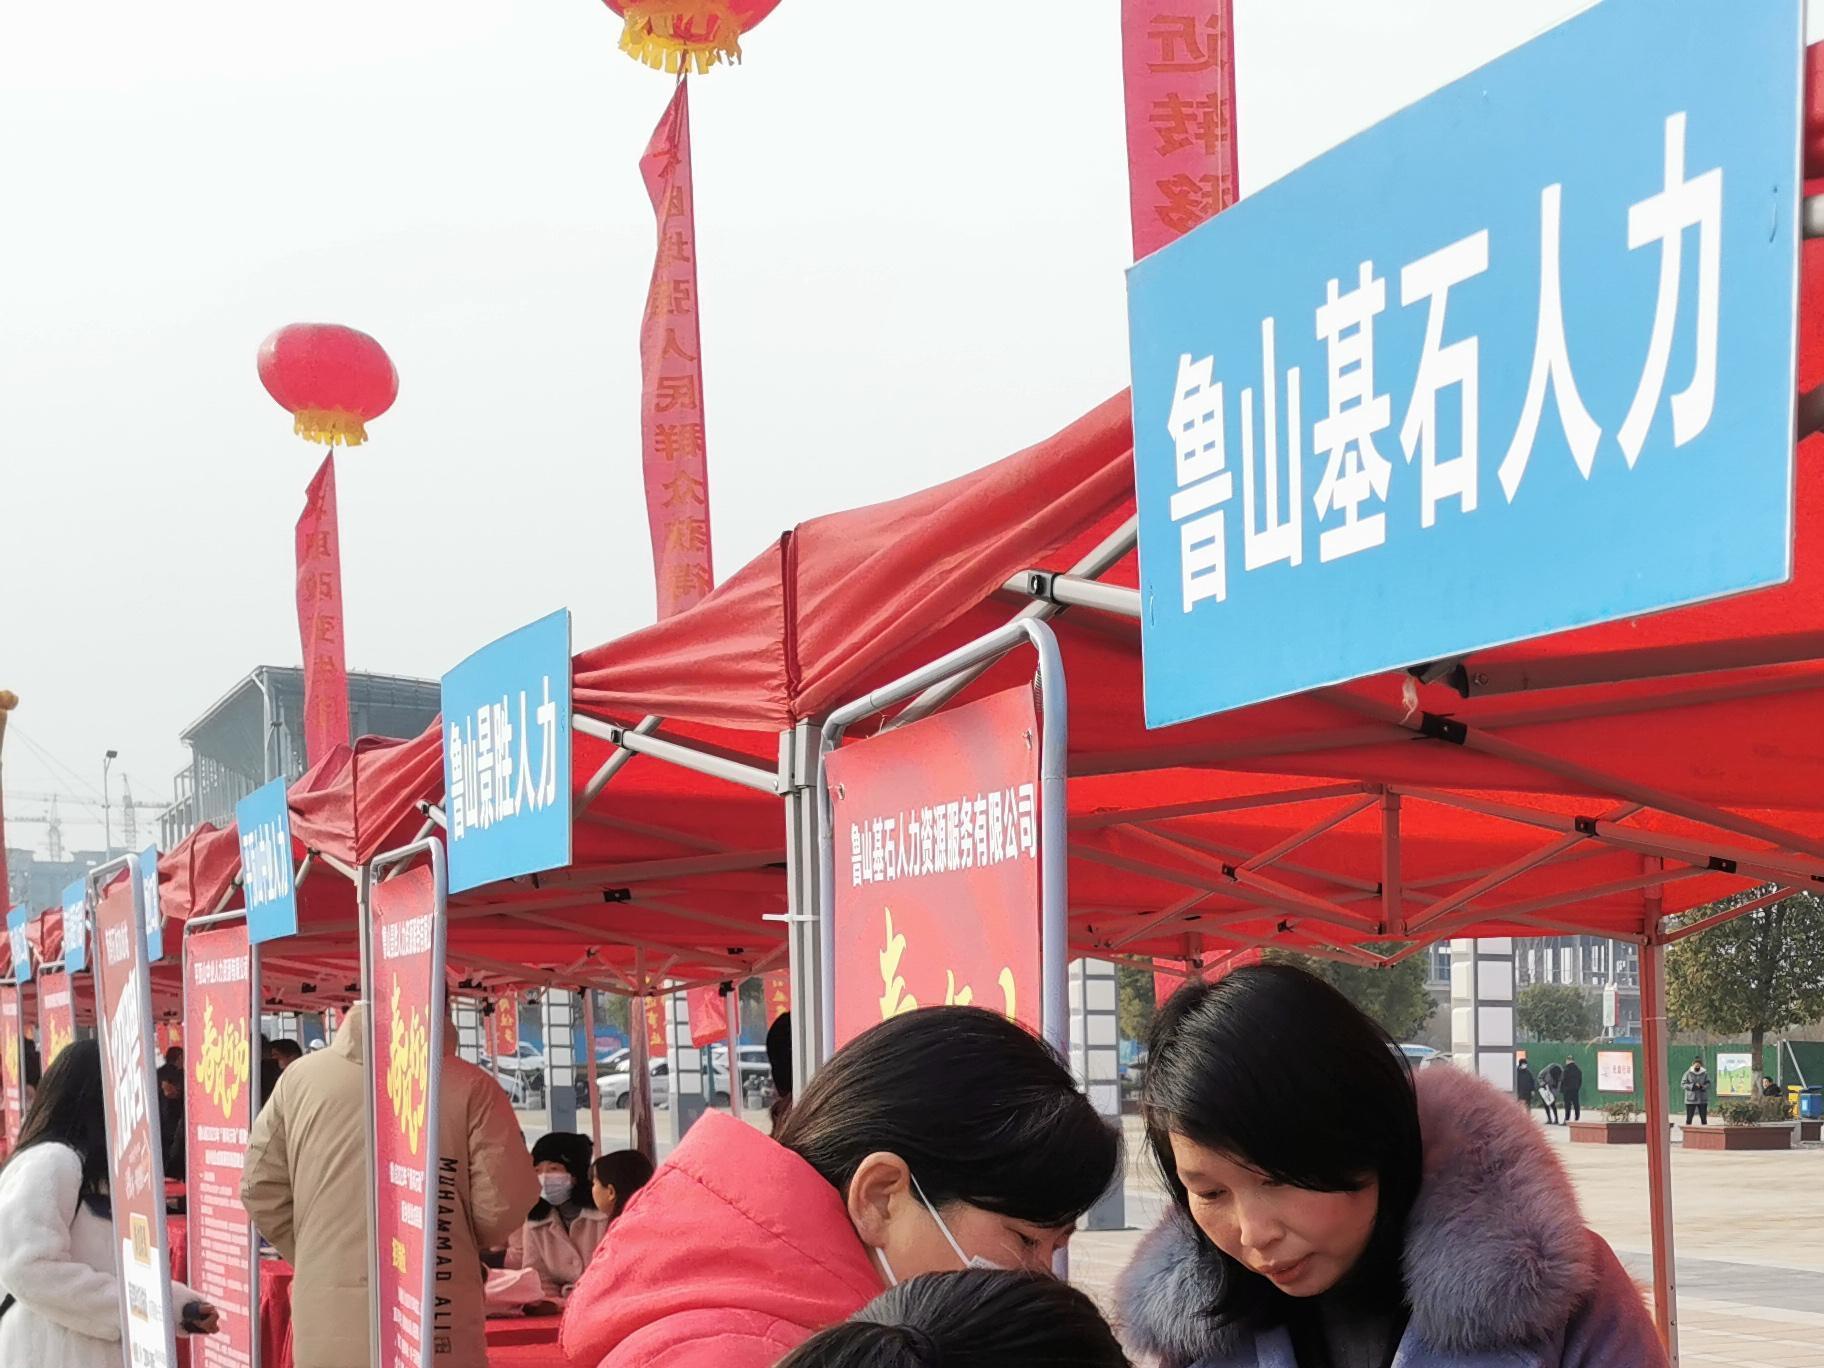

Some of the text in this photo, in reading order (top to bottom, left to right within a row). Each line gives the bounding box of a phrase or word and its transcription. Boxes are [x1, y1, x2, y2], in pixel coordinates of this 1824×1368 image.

[1167, 111, 1723, 613] 鲁山基石人力
[451, 675, 556, 842] 鲁山景胜人力
[850, 783, 1037, 887] 鲁山基石人力资源服务有限公司
[436, 1157, 458, 1282] MUHAMMAD
[434, 1296, 452, 1331] ALI
